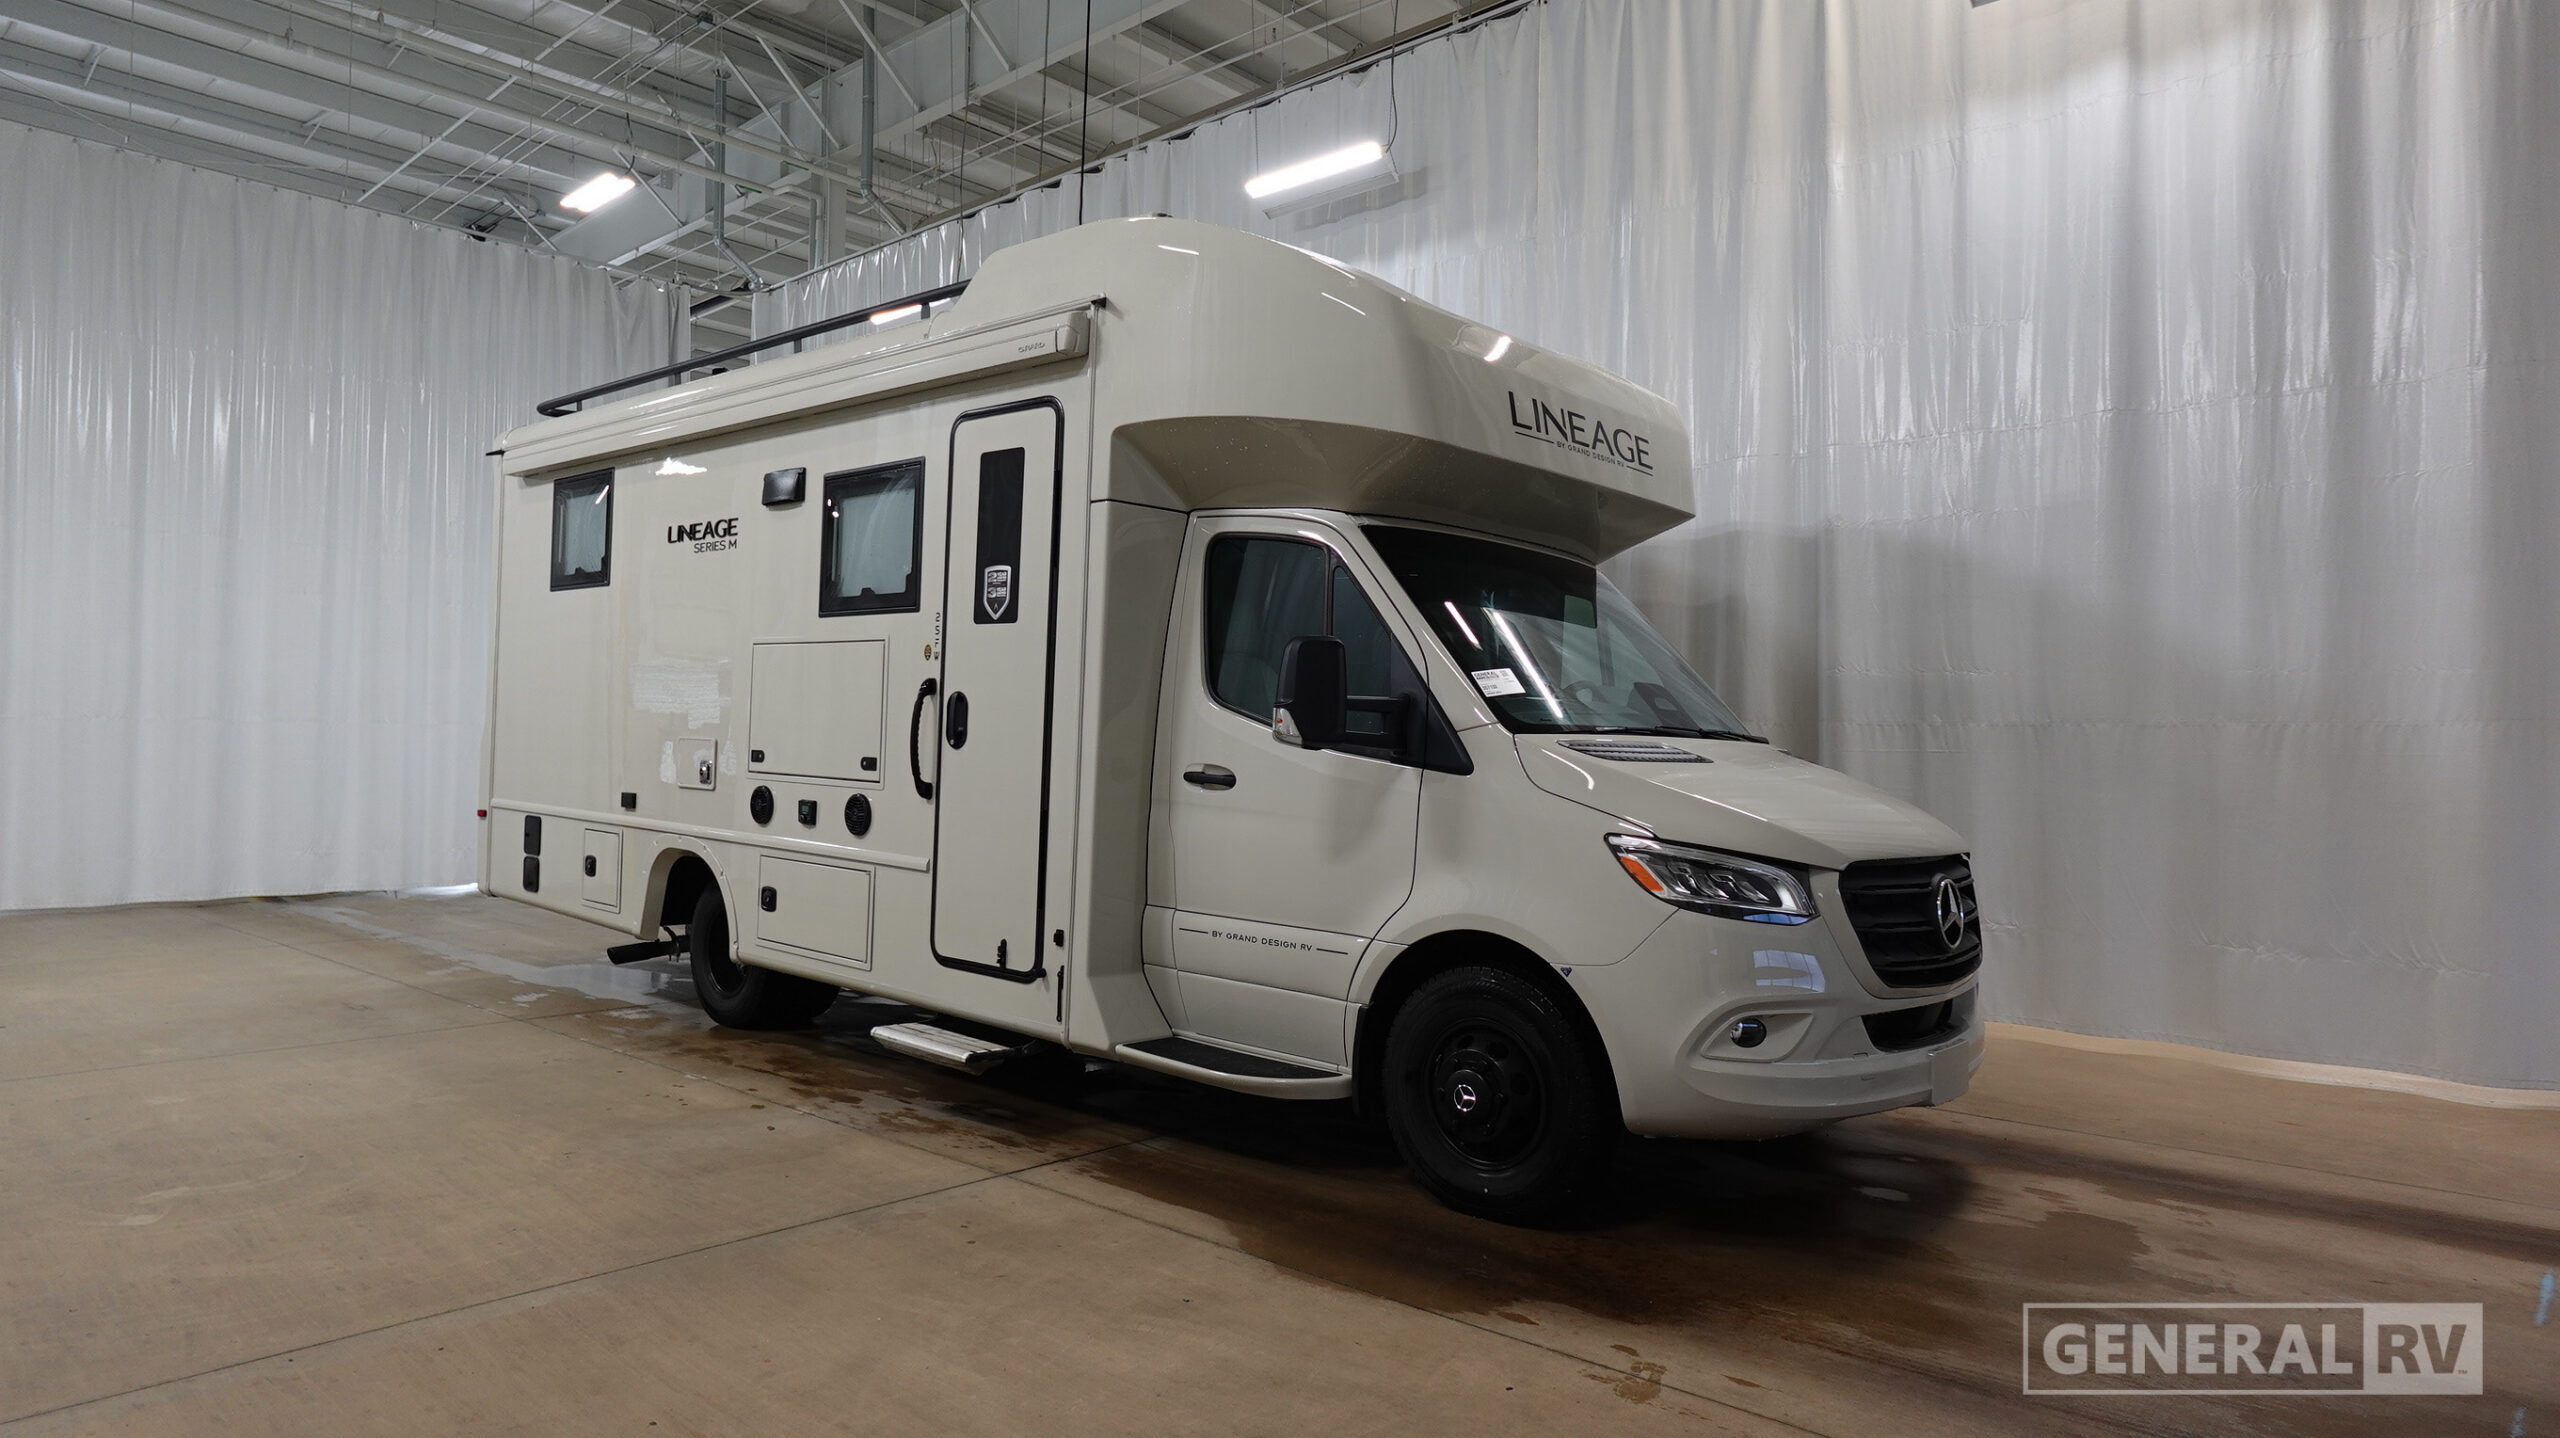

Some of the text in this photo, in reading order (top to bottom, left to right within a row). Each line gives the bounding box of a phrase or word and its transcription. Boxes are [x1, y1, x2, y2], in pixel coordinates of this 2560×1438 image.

[1508, 391, 1653, 470] LINEAGE
[1556, 440, 1566, 449] BY
[1567, 444, 1591, 457] GRAND
[1592, 452, 1616, 466] DESIGN
[667, 517, 739, 544] LINEAGE
[693, 539, 738, 554] SERIES M
[1211, 930, 1313, 951] BY GRAND DESIGN RV
